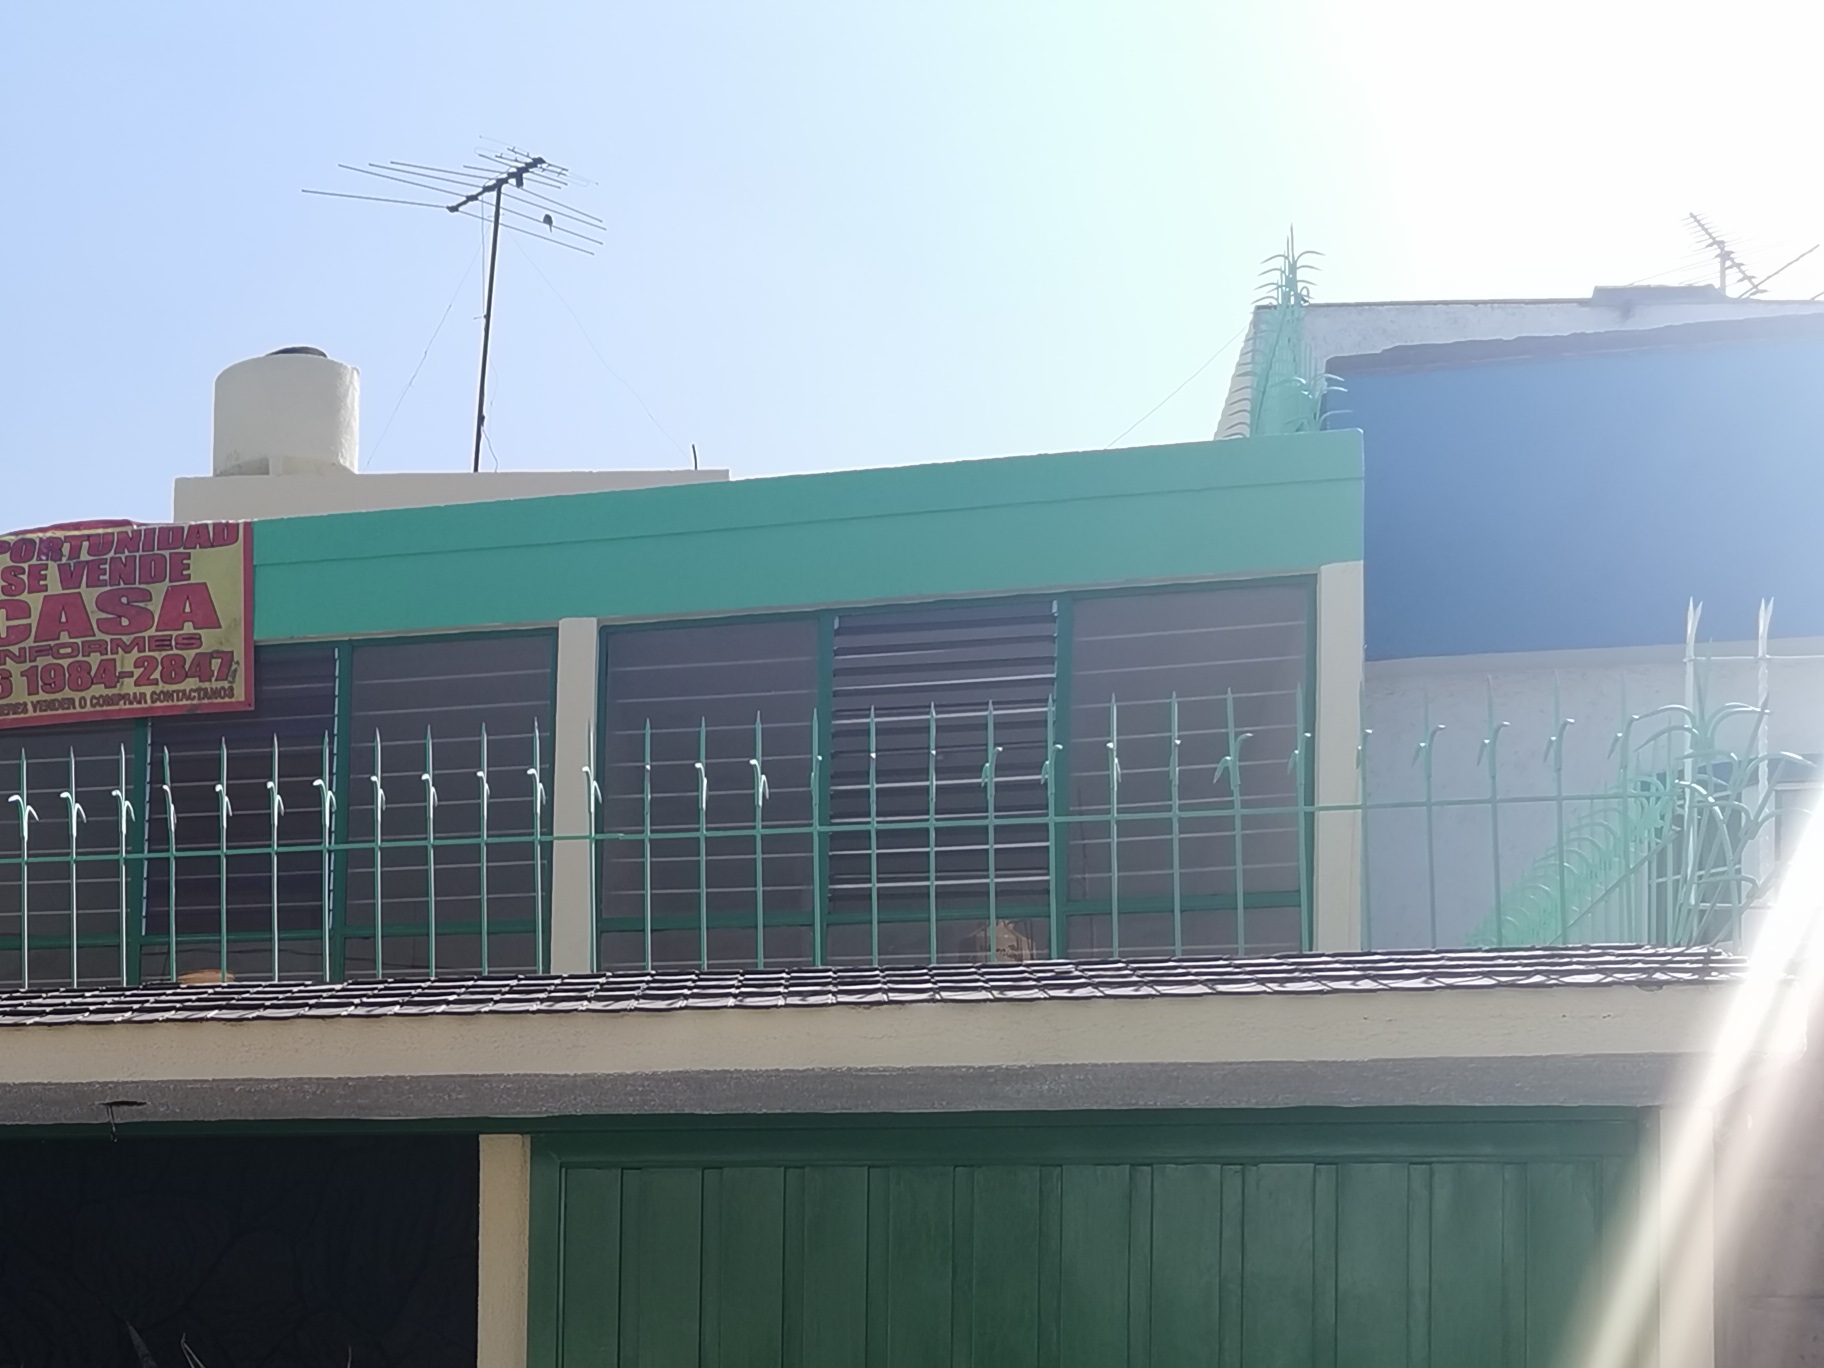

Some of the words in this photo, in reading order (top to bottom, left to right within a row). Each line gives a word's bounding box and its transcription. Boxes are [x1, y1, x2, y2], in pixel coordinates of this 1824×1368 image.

[1, 564, 49, 597] SE
[57, 552, 192, 590] VENDE
[20, 650, 234, 696] 1984-2847
[30, 697, 77, 713] VENDER
[79, 696, 87, 709] O
[90, 692, 147, 708] COMPRAR
